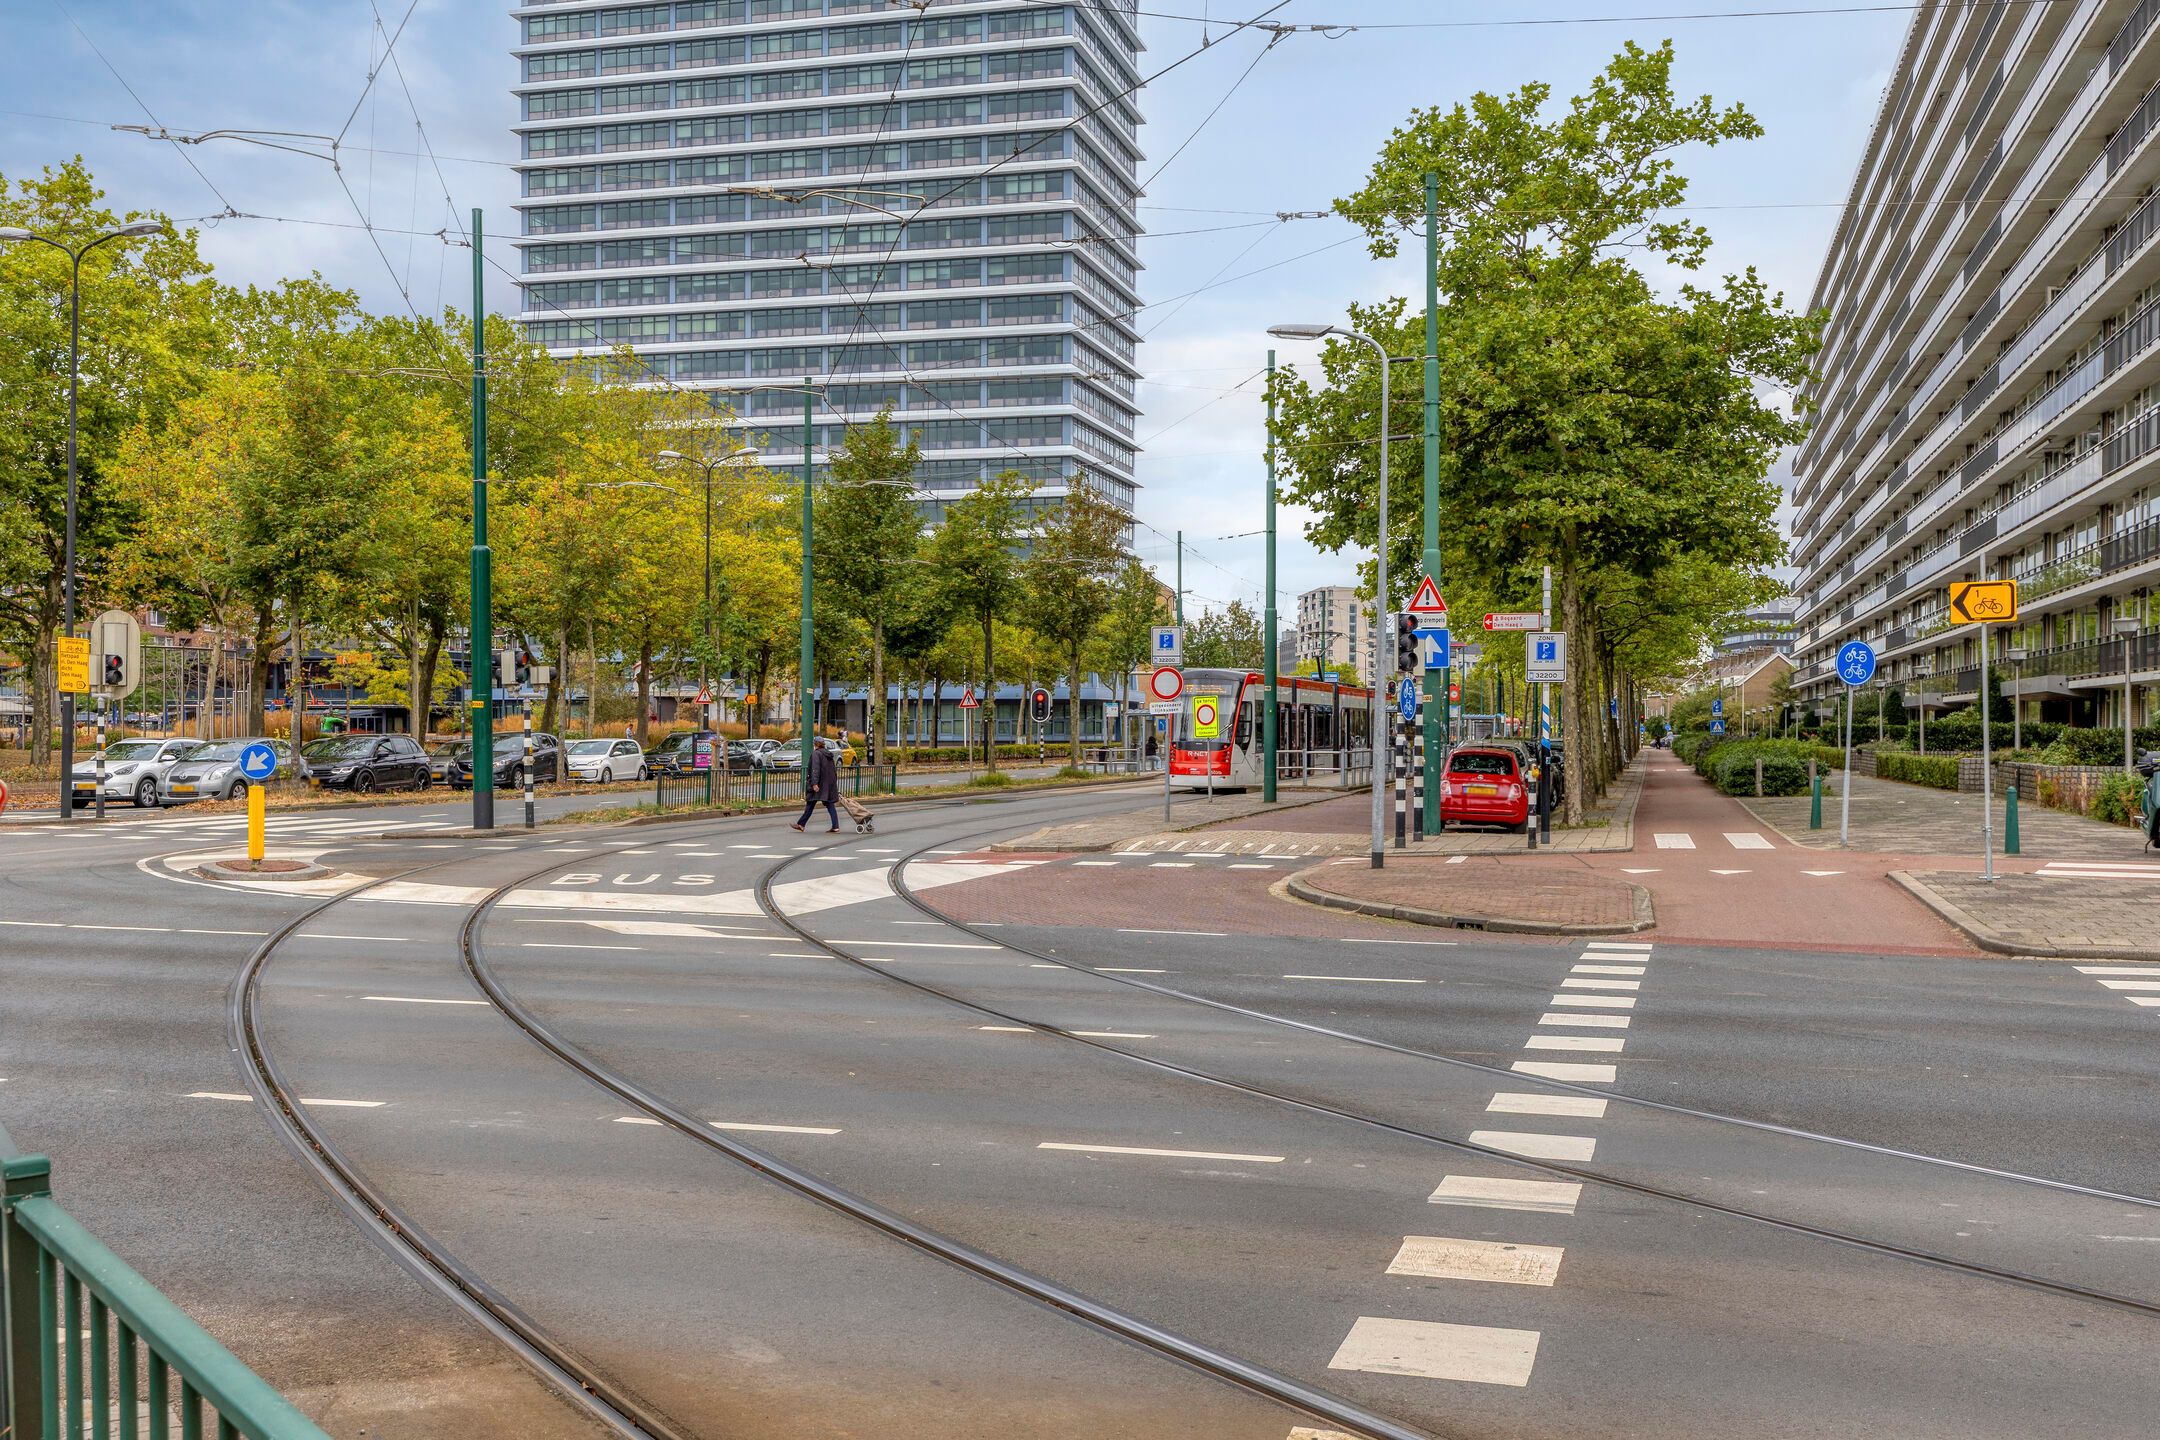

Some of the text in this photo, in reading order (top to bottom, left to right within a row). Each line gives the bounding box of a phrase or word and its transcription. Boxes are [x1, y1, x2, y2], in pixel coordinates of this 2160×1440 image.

[1976, 590, 1979, 598] 1
[1424, 616, 1445, 624] drempels
[1543, 643, 1550, 652] P
[550, 873, 717, 886] BUS
